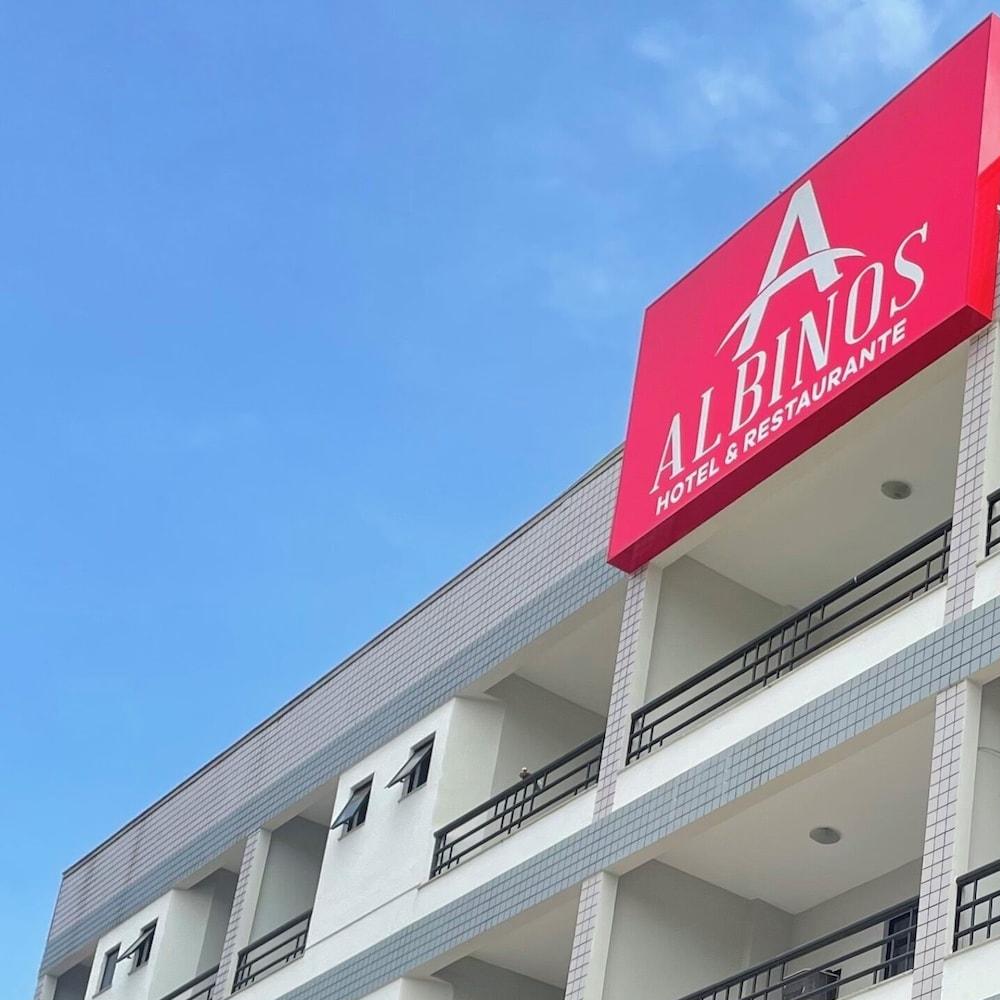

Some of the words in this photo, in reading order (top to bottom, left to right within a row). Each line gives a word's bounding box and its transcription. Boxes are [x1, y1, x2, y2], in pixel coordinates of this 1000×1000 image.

[649, 221, 929, 495] ALBINOS
[655, 462, 720, 516] HOTEL
[724, 441, 739, 465] &
[743, 318, 907, 450] RESTAURANTE
